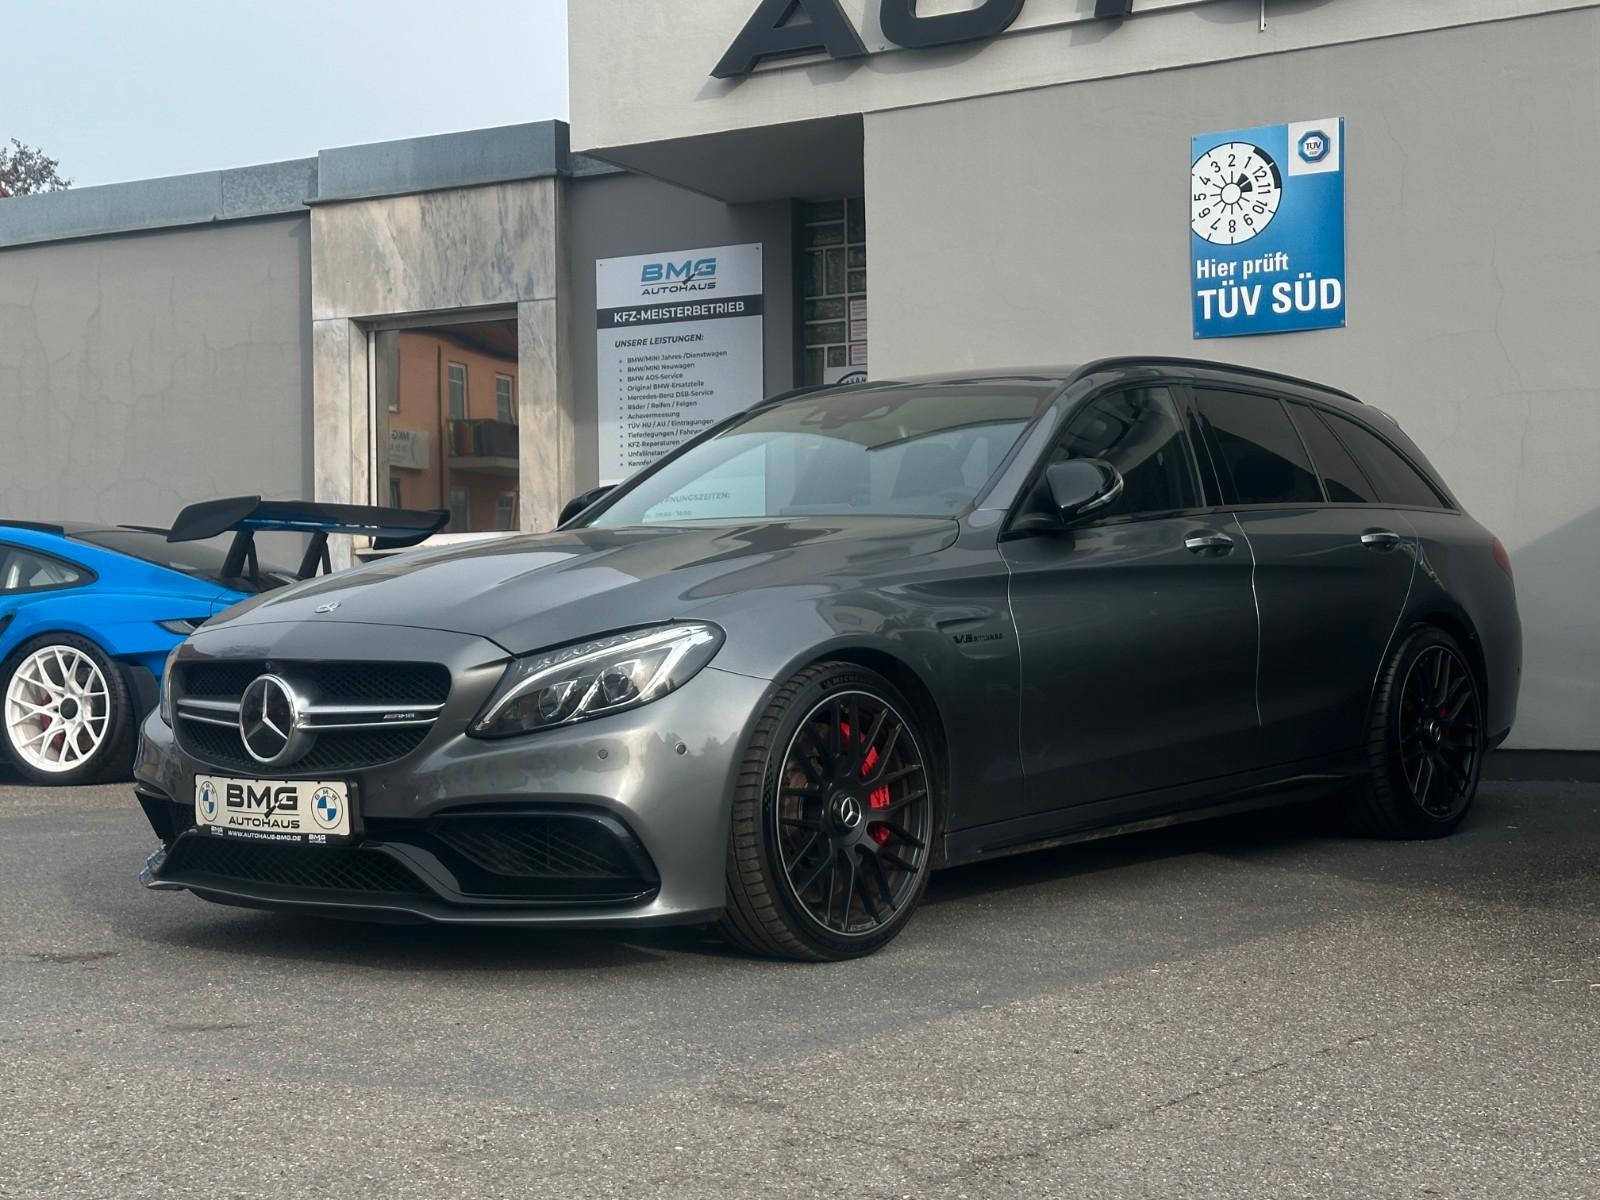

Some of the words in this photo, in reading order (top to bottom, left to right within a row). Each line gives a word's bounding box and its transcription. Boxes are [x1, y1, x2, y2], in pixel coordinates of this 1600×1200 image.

[1210, 160, 1221, 173] 3
[1228, 154, 1236, 167] 2
[1244, 156, 1252, 169] 1
[1252, 165, 1268, 182] 12
[1199, 176, 1211, 186] 4
[1257, 182, 1271, 195] 11
[1193, 193, 1207, 201] 5
[1198, 207, 1211, 219] 6
[1252, 200, 1268, 214] 10
[1210, 217, 1221, 231] 7
[1228, 219, 1236, 233] 8
[1243, 213, 1254, 226] 9
[640, 257, 717, 283] BMG
[1196, 258, 1237, 279] Hier
[1242, 251, 1289, 280] prüft
[641, 282, 716, 296] AUTOHAUS
[1197, 280, 1262, 320] TÜV
[1271, 272, 1342, 314] SÜD
[613, 301, 745, 324] KFZ-MEISTERBETRIEB
[614, 337, 648, 349] UNSERE
[649, 332, 705, 346] LEISTUNGEN:
[661, 362, 695, 371] Neuwagen
[627, 384, 652, 393] Original
[627, 391, 674, 401] Mercedes-Benz
[651, 401, 671, 409] Reifen
[676, 400, 698, 409] Felgen
[671, 418, 714, 427] Eintragungen
[628, 448, 669, 458] Unfallinstan
[226, 783, 299, 811] BMG
[228, 815, 300, 830] AUTOHAUS
